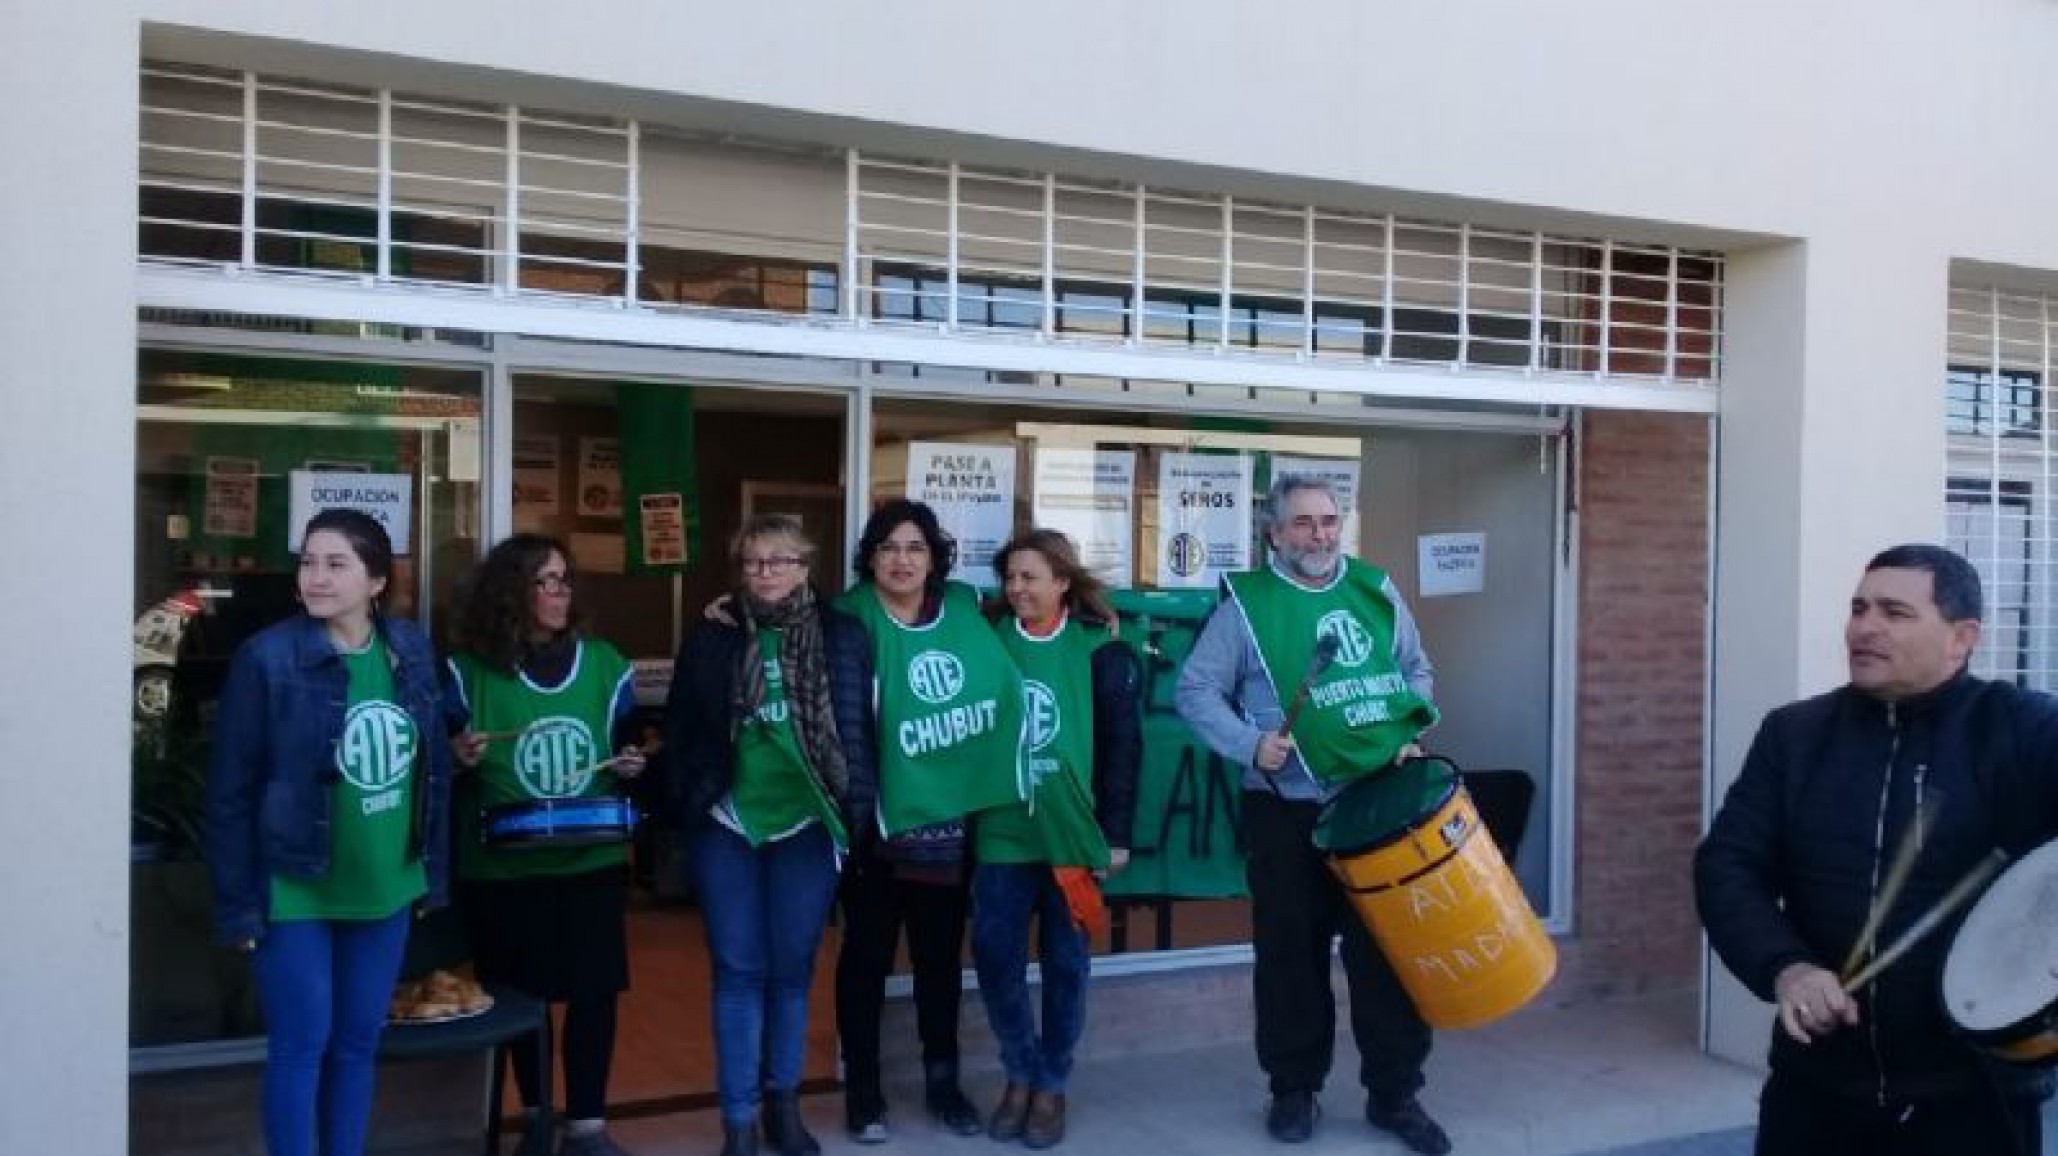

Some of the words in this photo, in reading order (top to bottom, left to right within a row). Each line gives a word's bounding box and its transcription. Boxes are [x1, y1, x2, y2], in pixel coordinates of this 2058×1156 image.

[925, 472, 997, 489] PLANTA
[930, 454, 977, 471] PASE
[911, 655, 962, 699] ATE
[345, 706, 412, 784] ATE
[898, 699, 998, 759] CHUBUT
[523, 724, 590, 795] ATE
